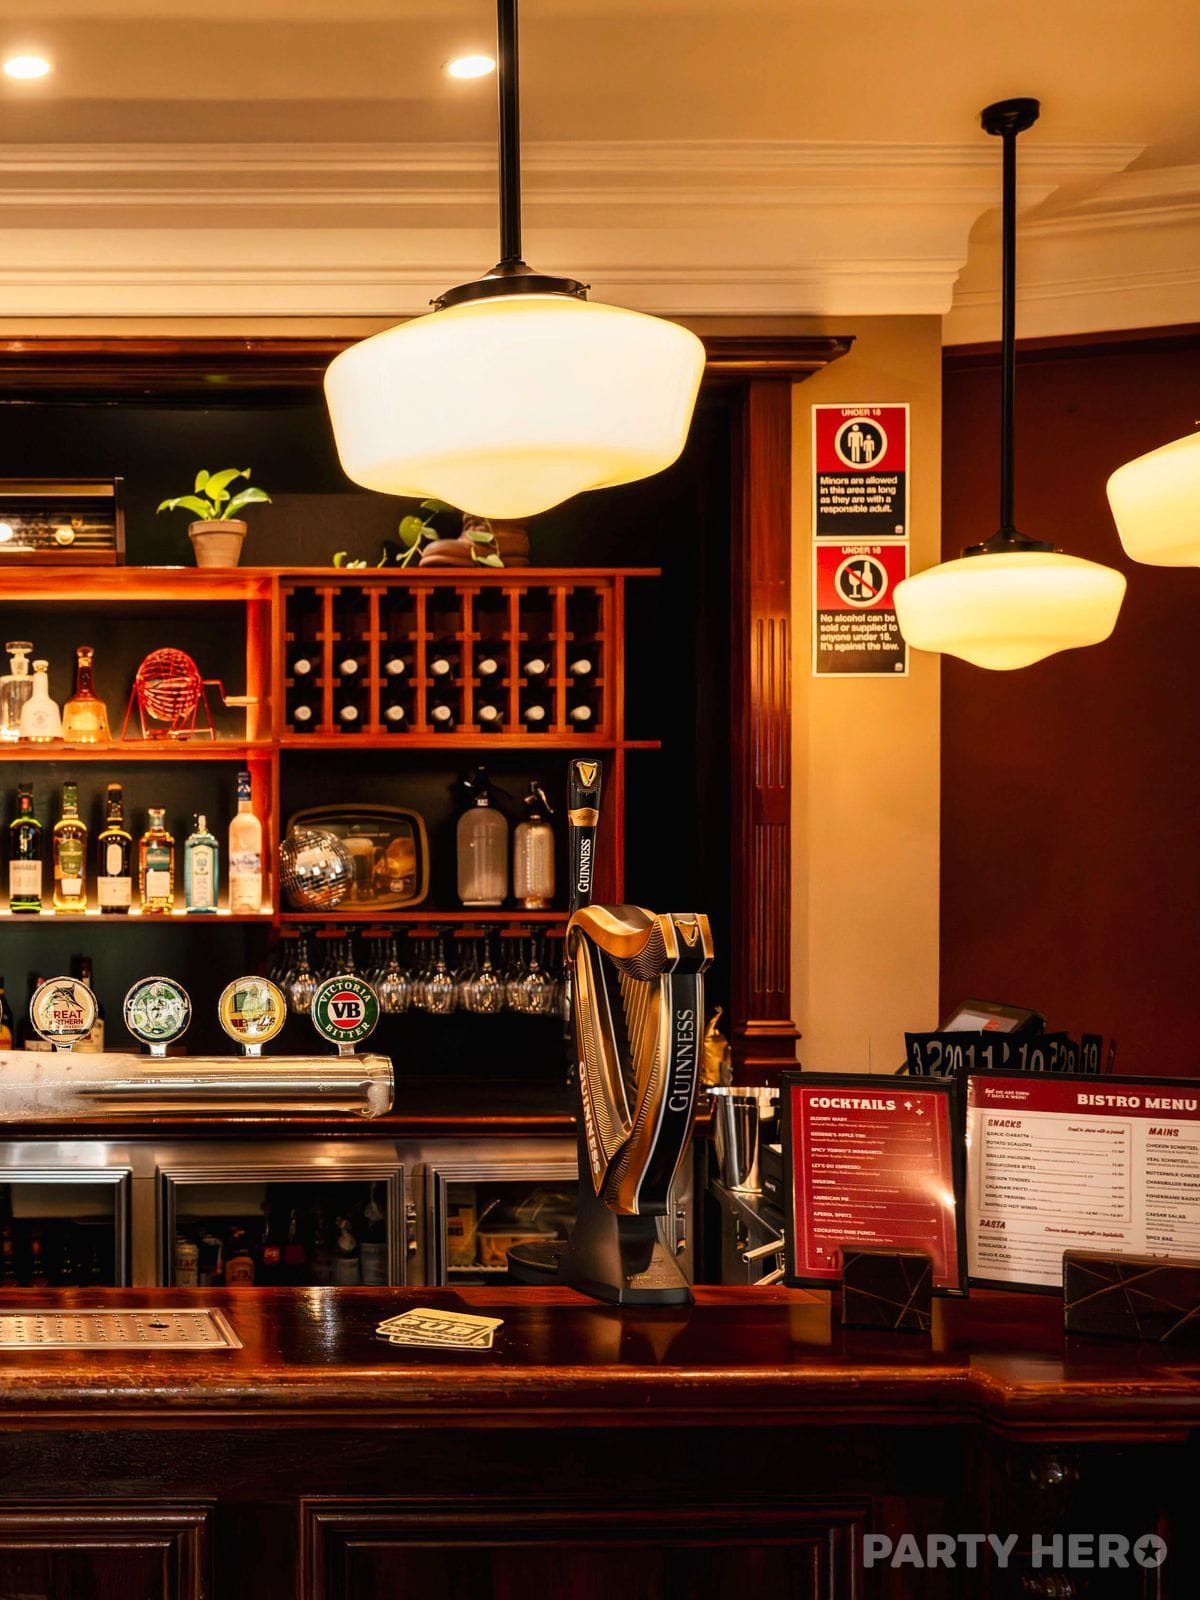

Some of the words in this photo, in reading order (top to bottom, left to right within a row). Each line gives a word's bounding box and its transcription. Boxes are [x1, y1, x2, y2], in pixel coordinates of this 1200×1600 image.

[866, 476, 897, 484] allowed
[878, 486, 896, 495] long
[832, 496, 850, 504] they
[820, 504, 868, 514] responsible
[869, 504, 892, 512] adult.
[820, 614, 833, 622] No
[835, 614, 865, 622] alcohol
[884, 614, 895, 622] be
[820, 624, 838, 632] sold
[852, 624, 887, 633] supplied
[820, 634, 851, 642] anyone
[853, 632, 877, 640] under
[820, 642, 833, 650] It's
[835, 642, 866, 652] against
[868, 642, 881, 650] the
[882, 642, 899, 650] law.
[578, 838, 591, 892] GUINNESS
[320, 982, 371, 1002] VICTORIA
[331, 1002, 360, 1018] VB
[325, 1022, 370, 1038] BITTER
[668, 1010, 694, 1112] GUINNESS
[927, 1041, 942, 1076] 2
[809, 1098, 896, 1110] COCKTAILS
[1077, 1093, 1140, 1108] BISTRO
[1145, 1097, 1198, 1111] MENU
[580, 1061, 601, 1174] GUINNESS
[988, 1119, 1022, 1128] SNACKS
[1148, 1128, 1180, 1136] MAINS
[979, 1220, 1006, 1229] PASTA
[393, 1318, 475, 1335] PUB
